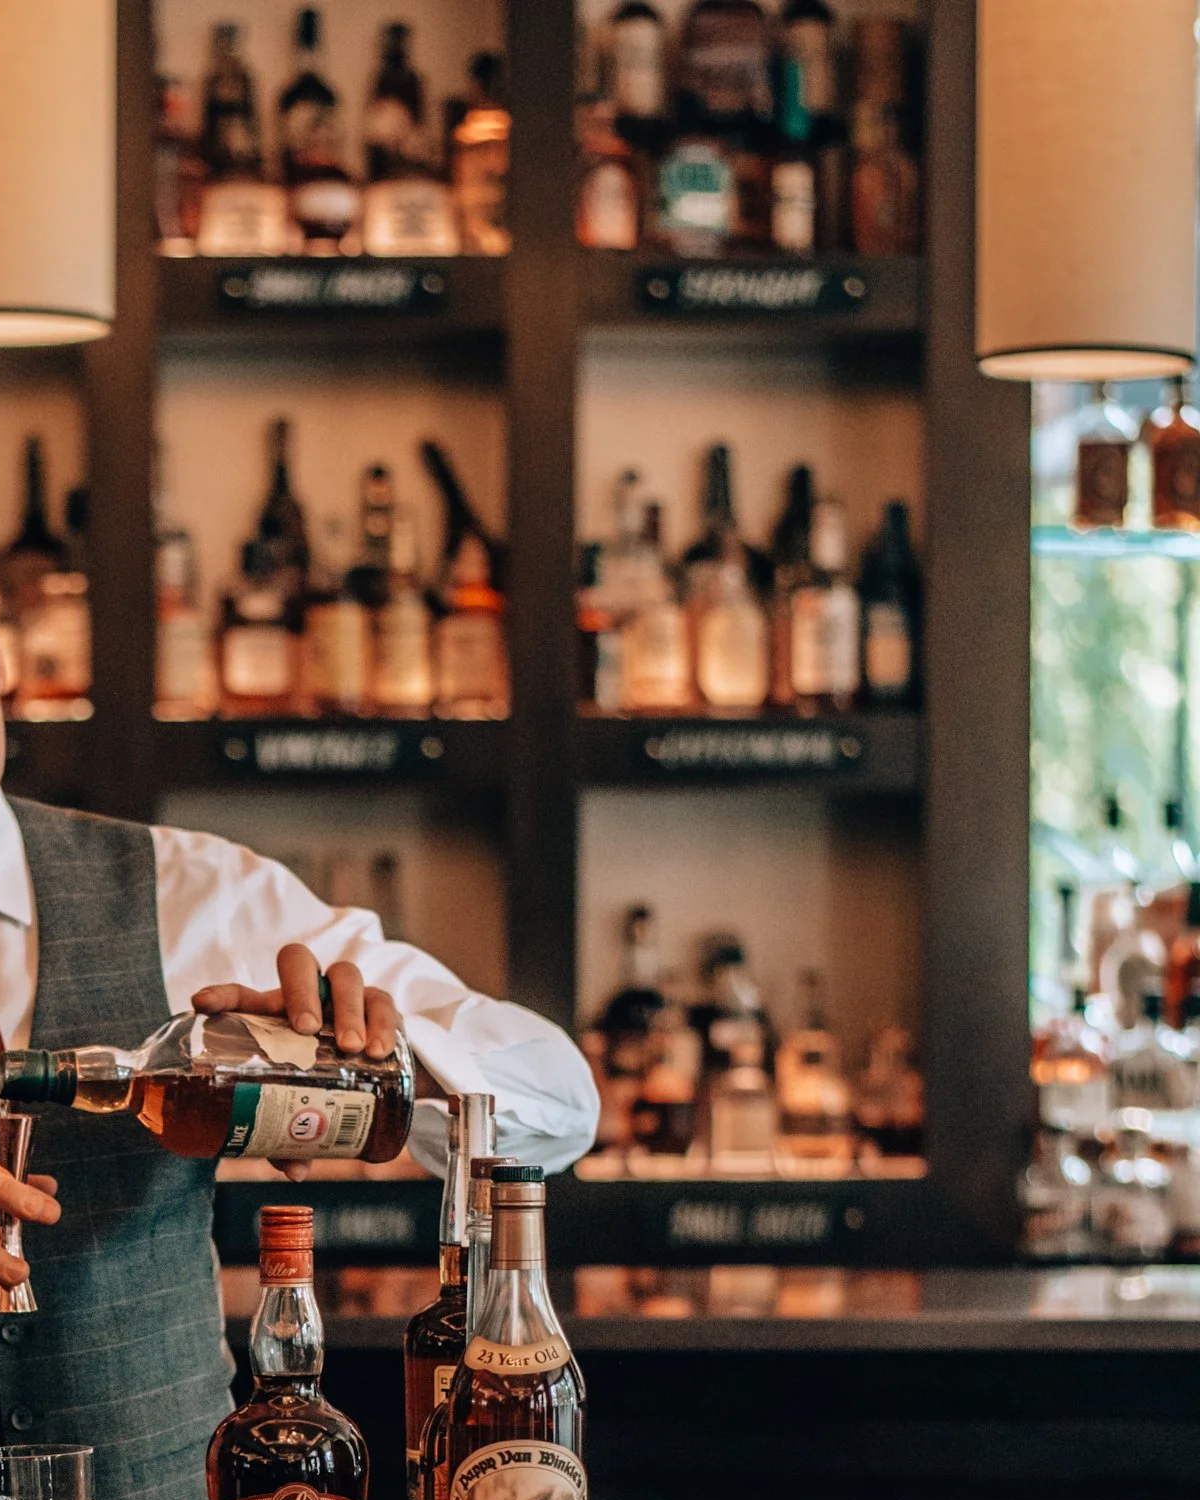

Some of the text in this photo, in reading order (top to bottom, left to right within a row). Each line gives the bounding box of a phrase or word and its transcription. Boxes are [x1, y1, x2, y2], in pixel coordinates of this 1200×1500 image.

[477, 1346, 559, 1367] 23 Year Old
[459, 1450, 582, 1491] Pappy Van Winkle's
